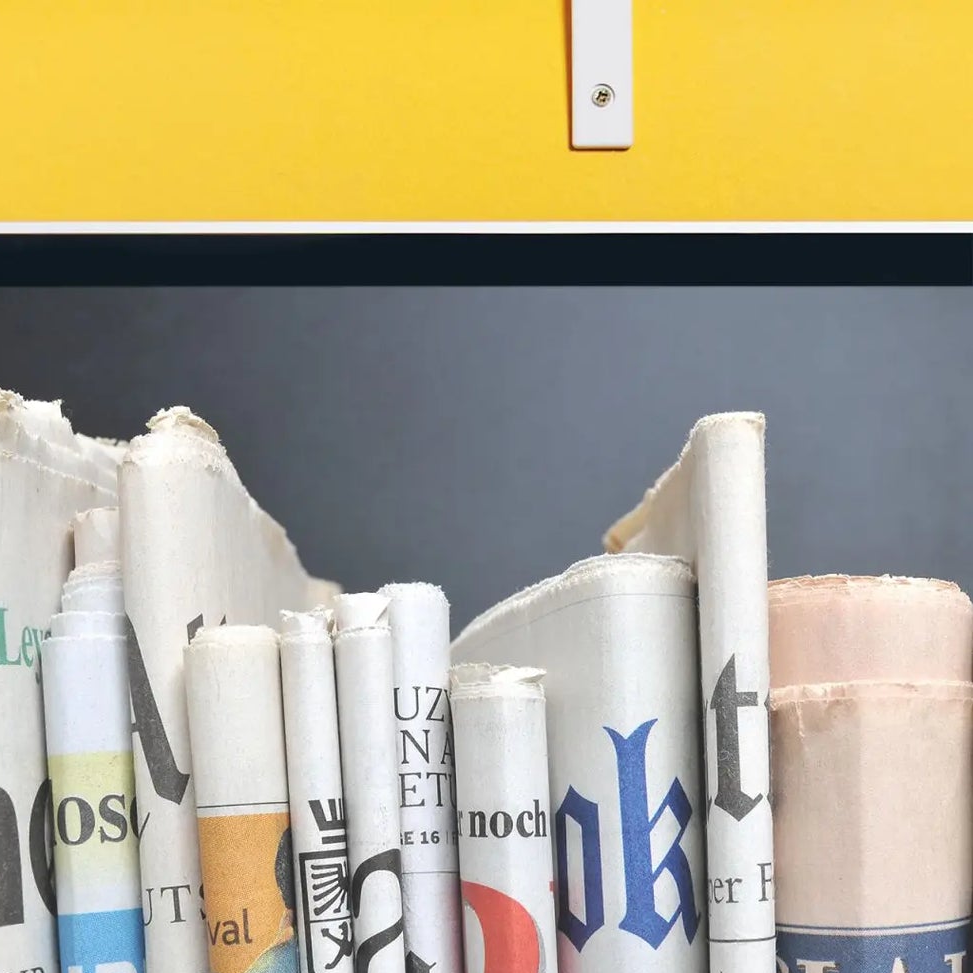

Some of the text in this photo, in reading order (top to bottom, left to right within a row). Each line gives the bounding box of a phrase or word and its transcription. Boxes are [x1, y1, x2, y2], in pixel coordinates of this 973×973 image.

[393, 686, 454, 722] UZ
[468, 799, 548, 839] noch
[420, 831, 440, 844] 16
